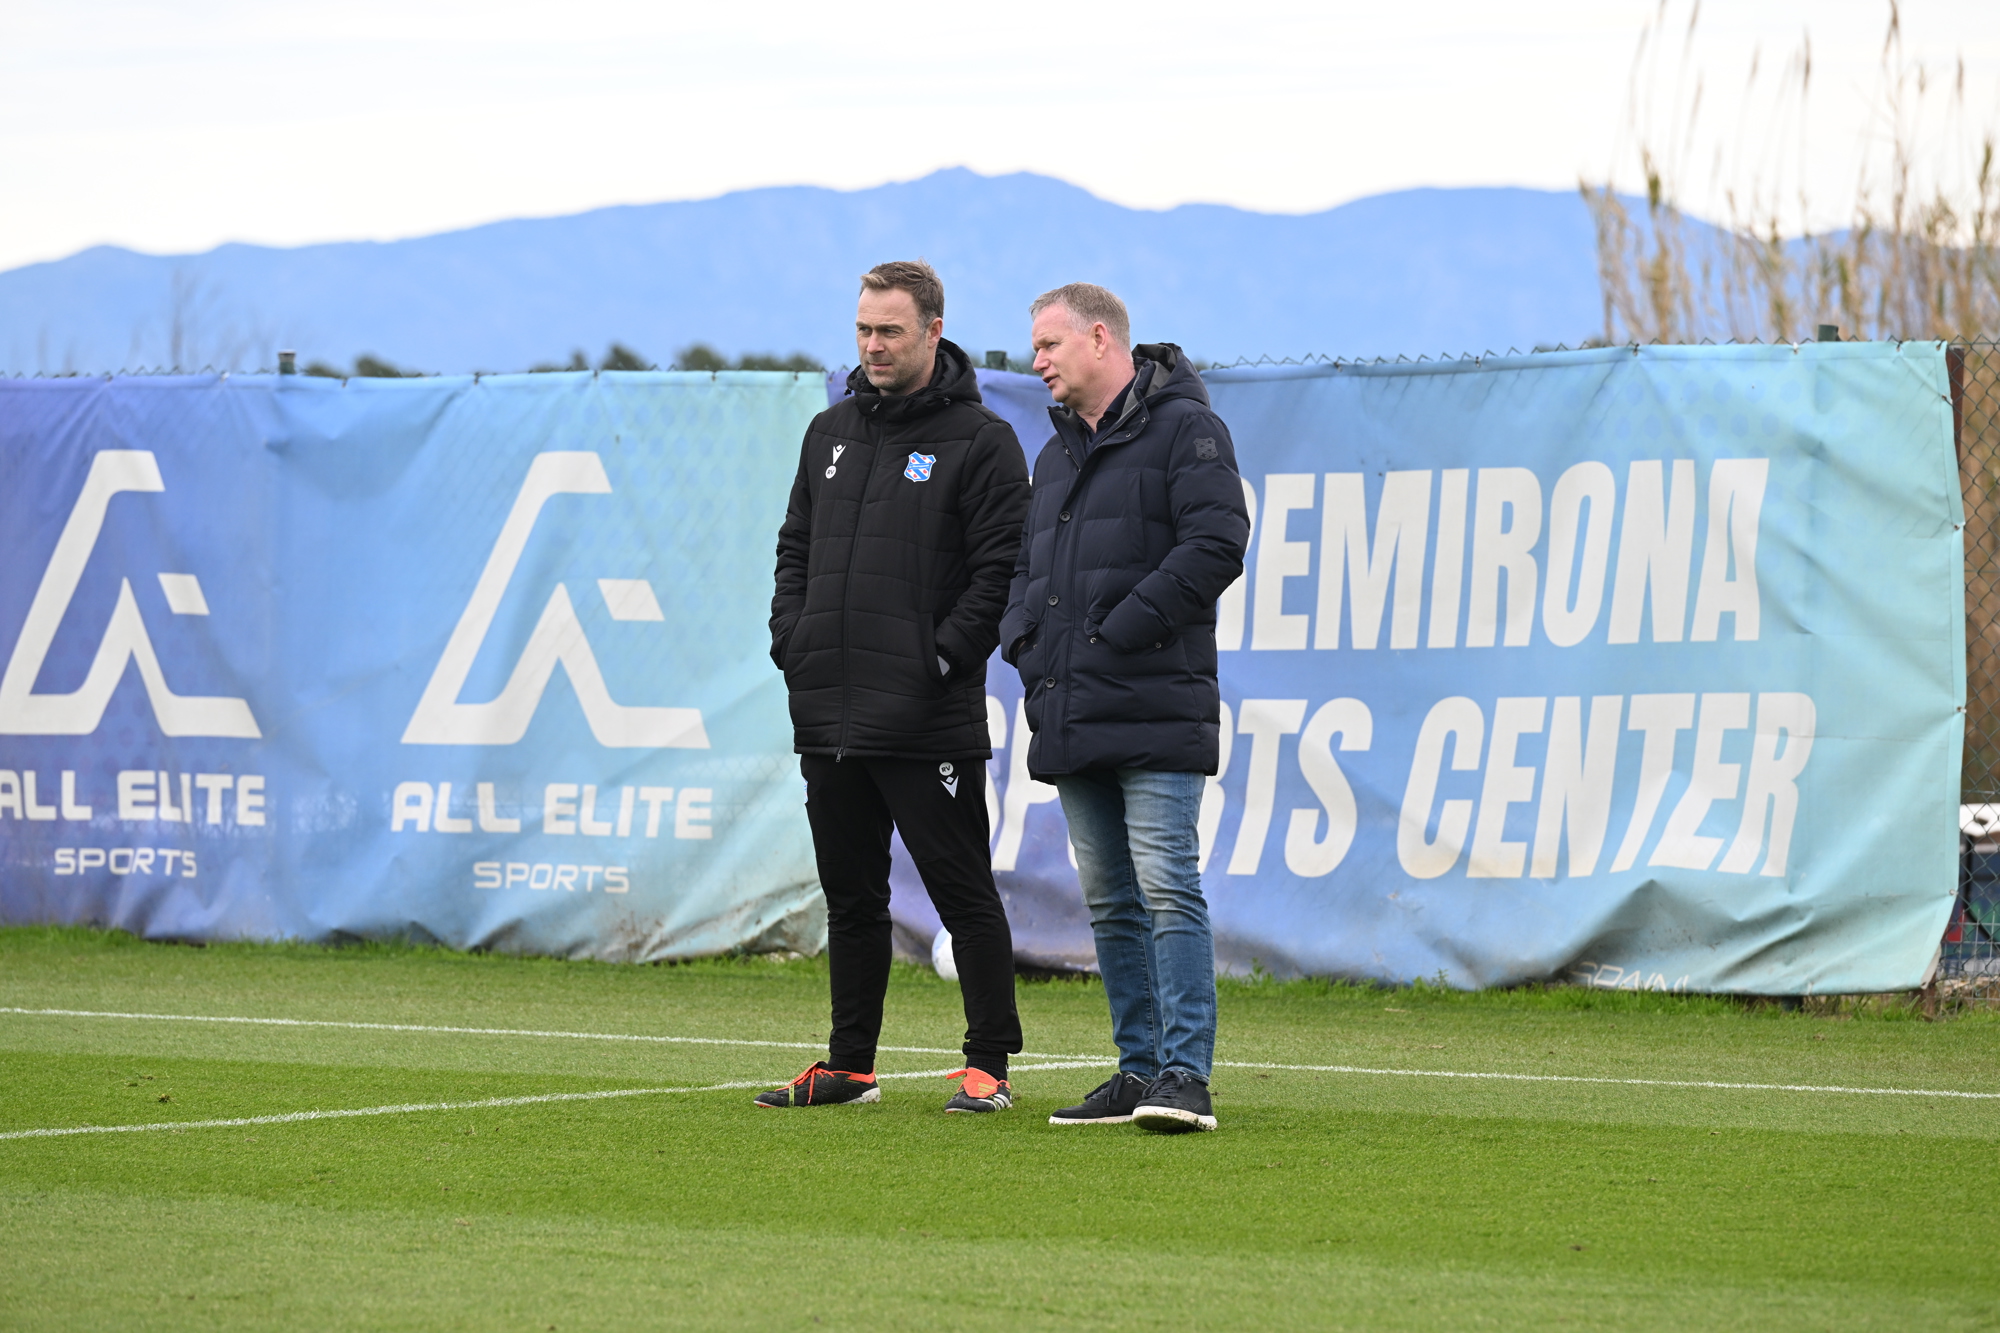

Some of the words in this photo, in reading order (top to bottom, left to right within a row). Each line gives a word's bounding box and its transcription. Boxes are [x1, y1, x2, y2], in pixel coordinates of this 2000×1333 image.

[117, 770, 265, 826] ELITE
[391, 781, 521, 833] ALL
[543, 783, 713, 839] ELITE
[1397, 692, 1816, 879] CENTER
[54, 847, 197, 878] SPORTS
[473, 861, 630, 894] SPORTS
